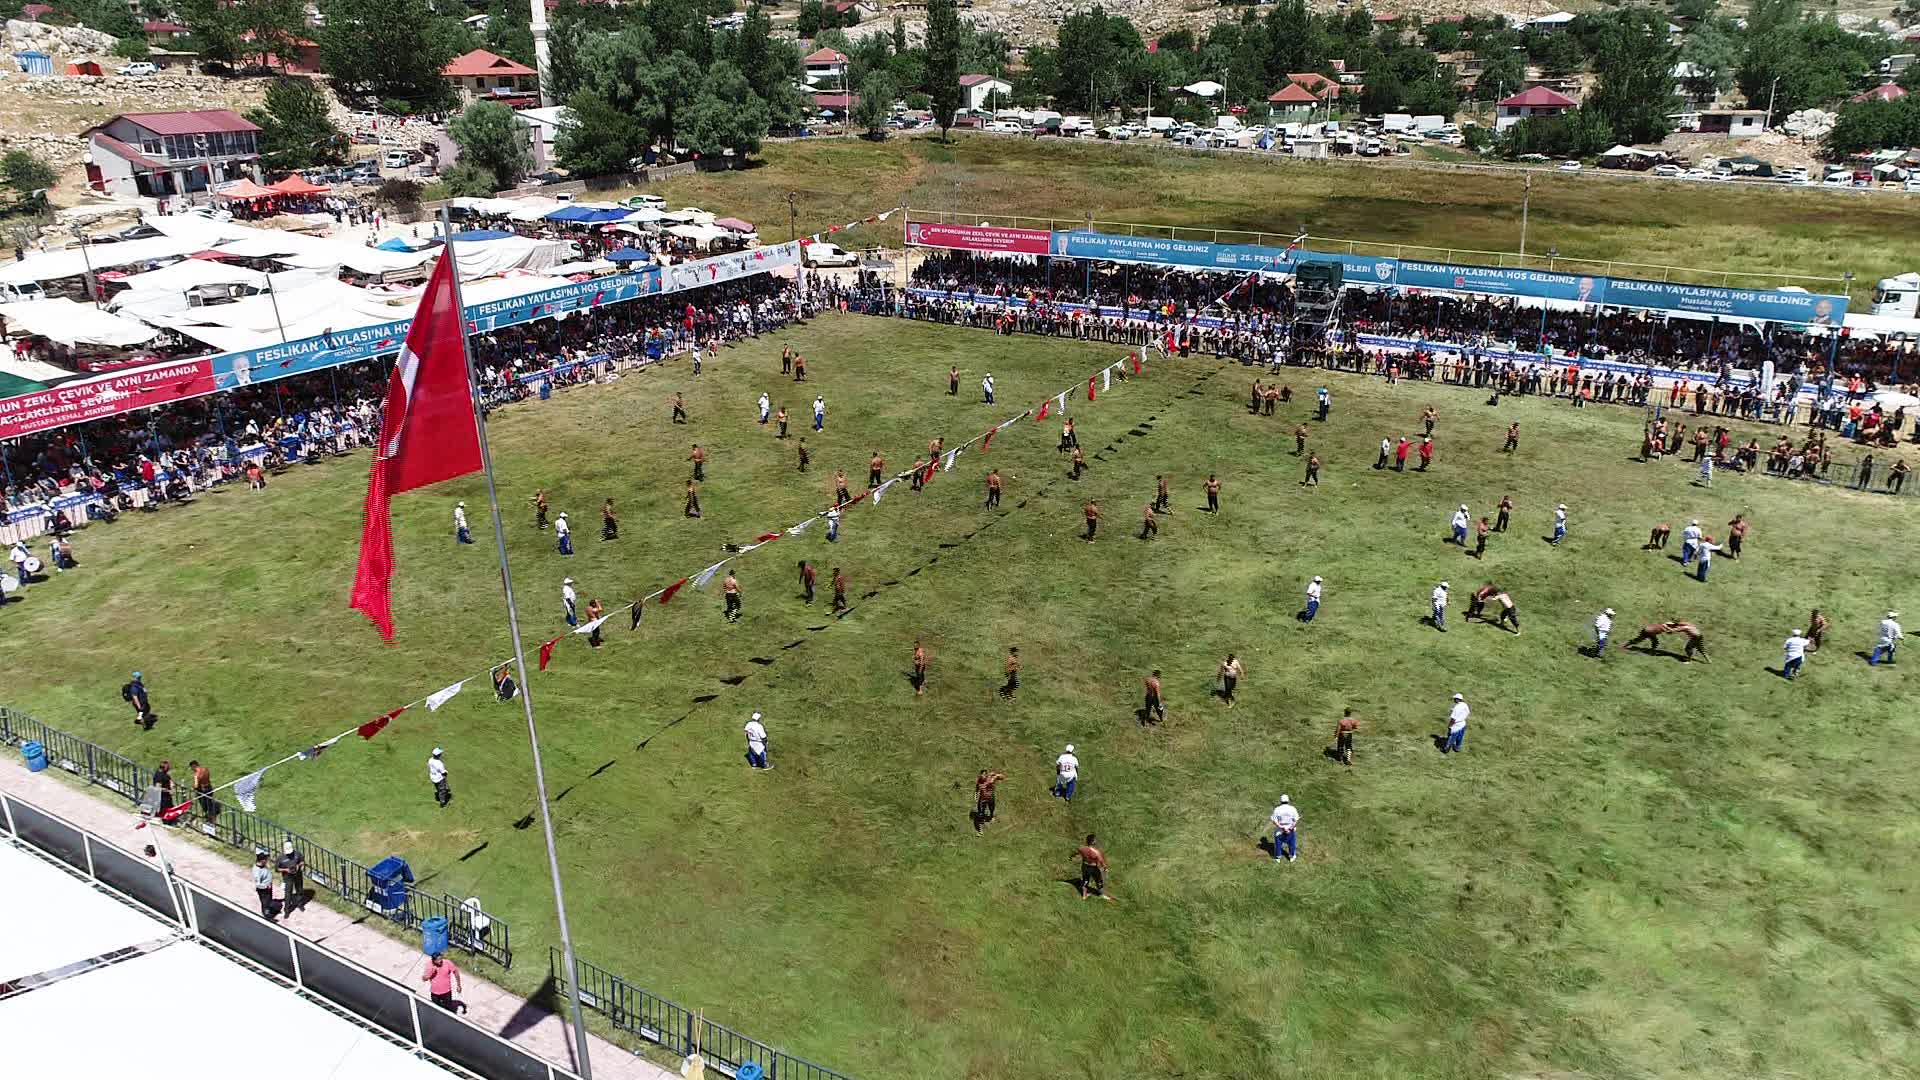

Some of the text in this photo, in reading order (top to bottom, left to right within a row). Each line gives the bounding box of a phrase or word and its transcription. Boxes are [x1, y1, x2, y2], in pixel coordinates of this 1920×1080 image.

[394, 322, 411, 334] HO
[97, 382, 113, 393] VE
[115, 375, 142, 388] AYNI
[144, 365, 199, 382] ZAMANDA
[56, 412, 82, 423] KEMAL
